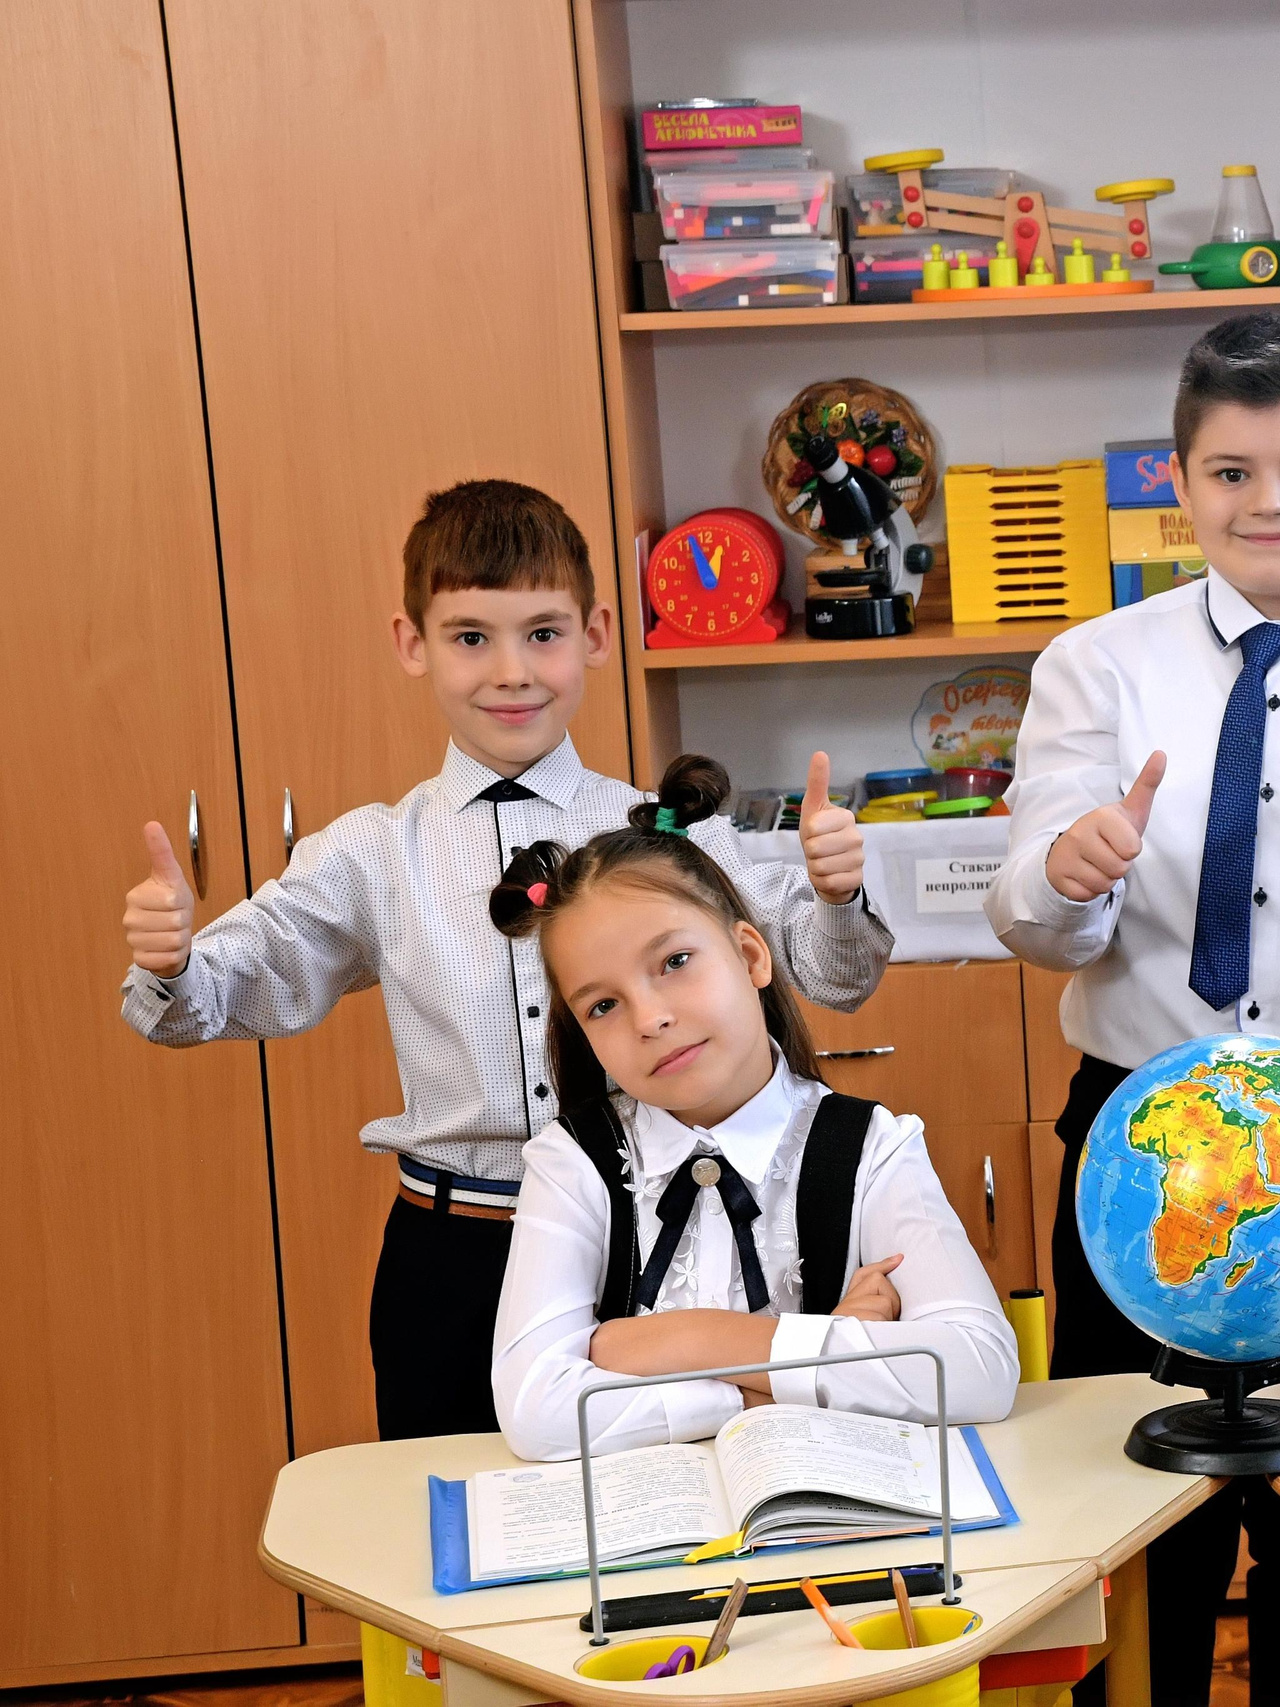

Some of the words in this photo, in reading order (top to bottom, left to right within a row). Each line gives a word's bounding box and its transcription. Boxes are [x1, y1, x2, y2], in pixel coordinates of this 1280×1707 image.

[653, 111, 709, 129] ВЕСЕЛА
[698, 531, 713, 544] 12
[725, 536, 730, 547] 1
[663, 557, 678, 569] 10
[742, 551, 750, 563] 2
[751, 572, 758, 584] 3
[658, 578, 666, 591] 9
[667, 600, 675, 612] 8
[745, 594, 753, 606] 4
[685, 614, 693, 626] 7
[730, 612, 737, 624] 5
[707, 619, 716, 631] 6
